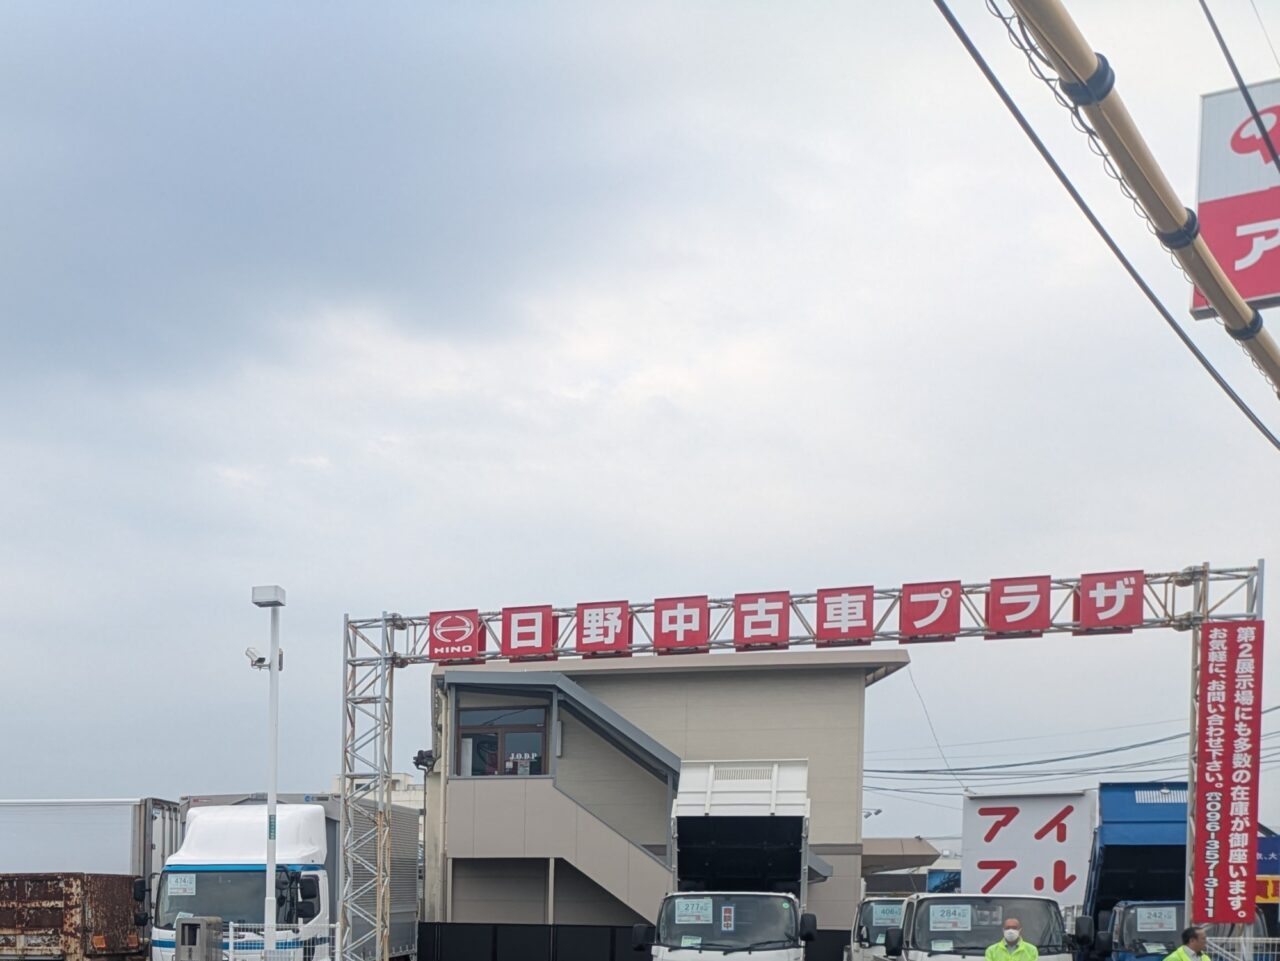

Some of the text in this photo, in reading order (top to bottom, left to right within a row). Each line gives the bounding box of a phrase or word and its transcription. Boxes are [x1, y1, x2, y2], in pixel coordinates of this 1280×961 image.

[510, 576, 1137, 649] 日野中古車プラザ
[434, 645, 473, 654] HINO
